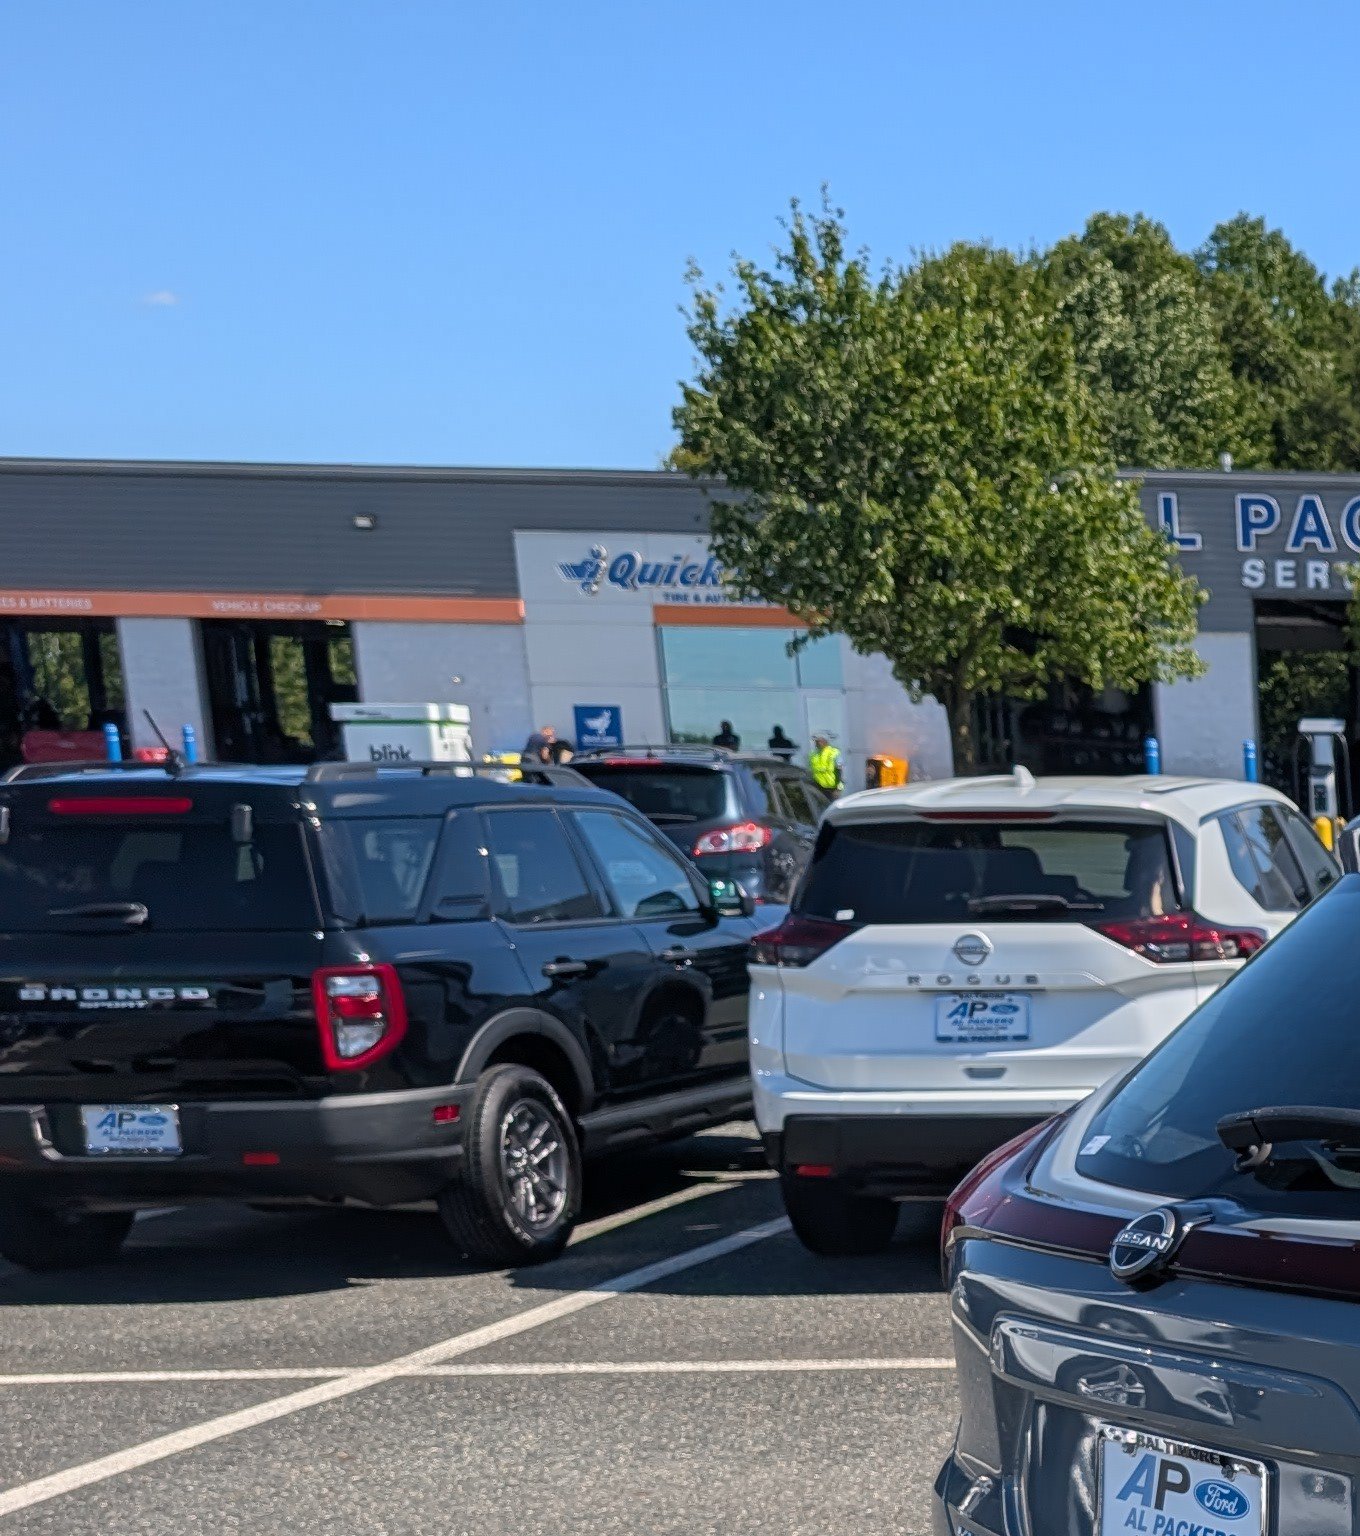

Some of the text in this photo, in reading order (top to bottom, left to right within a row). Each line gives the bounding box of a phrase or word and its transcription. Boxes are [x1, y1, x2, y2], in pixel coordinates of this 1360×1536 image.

[1157, 492, 1202, 551] L
[608, 551, 725, 591] Quick
[369, 743, 412, 761] blink
[907, 974, 1038, 985] ROGUE
[19, 987, 209, 1000] BRONCO
[946, 1001, 989, 1018] AP
[96, 1112, 137, 1129] AP
[1114, 1231, 1168, 1250] ISSAN
[1116, 1453, 1191, 1512] AP
[1201, 1484, 1239, 1515] Ford
[1124, 1507, 1149, 1532] AL
